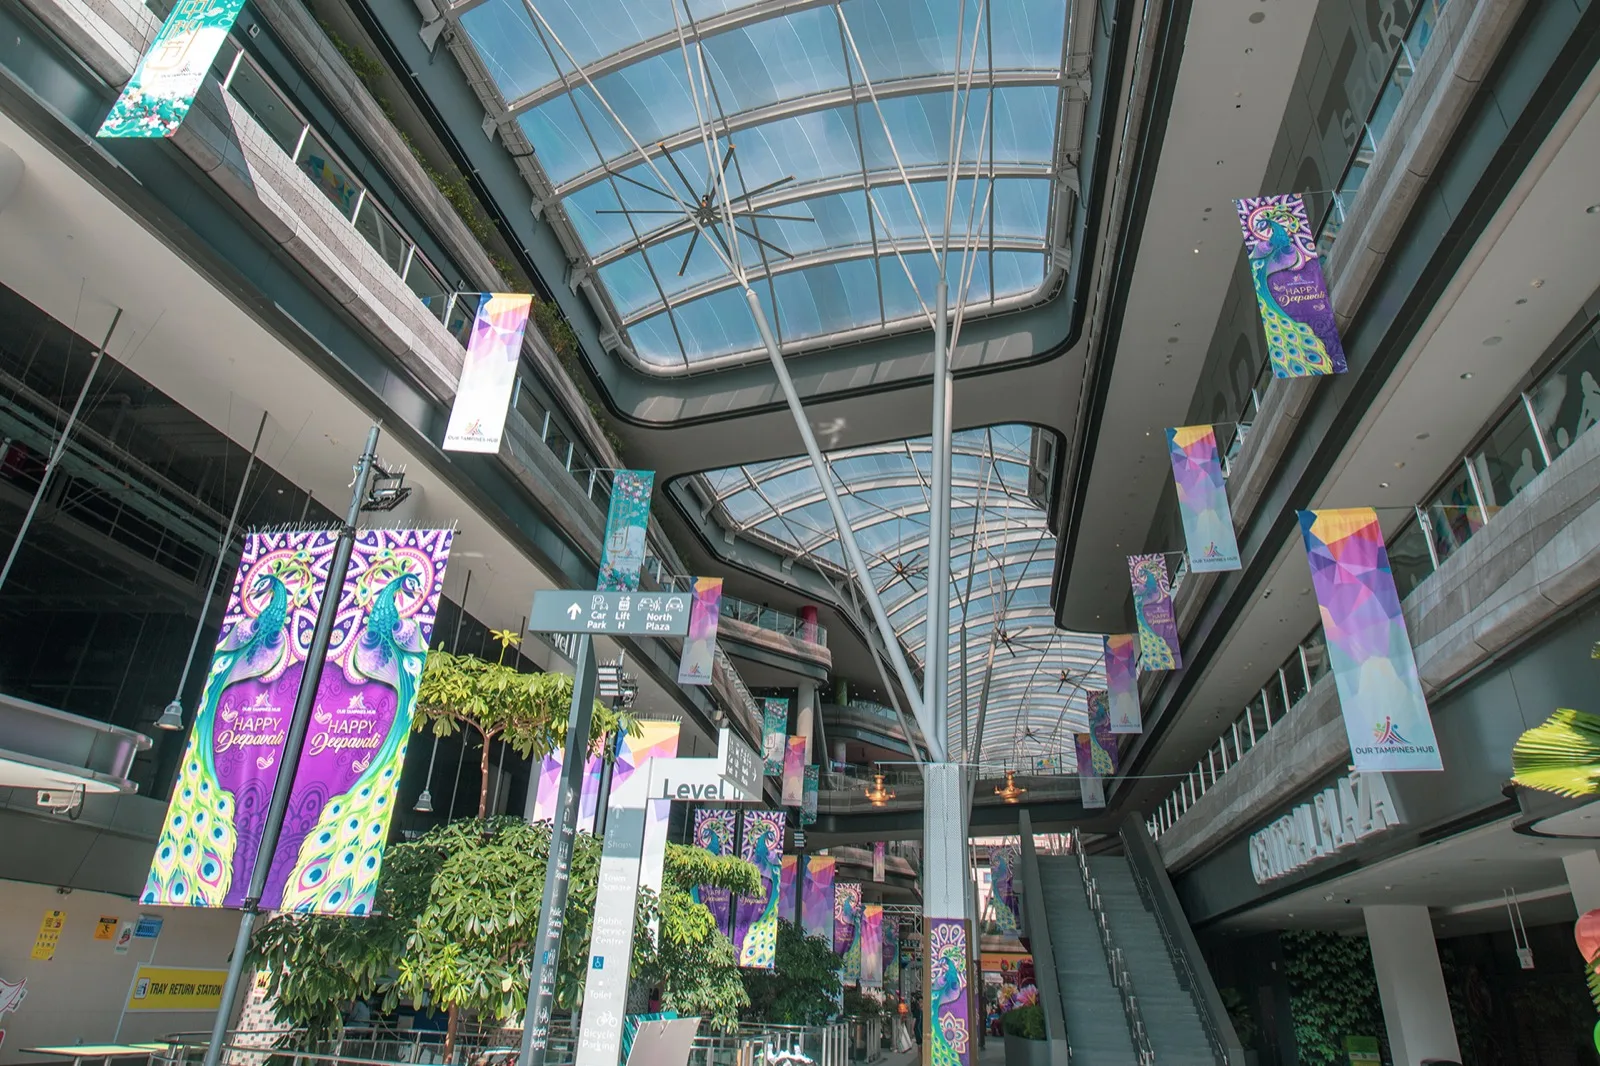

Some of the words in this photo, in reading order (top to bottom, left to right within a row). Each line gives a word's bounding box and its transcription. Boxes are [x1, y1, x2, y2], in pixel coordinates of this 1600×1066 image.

[1285, 285, 1318, 295] HAPPY
[1279, 291, 1325, 306] Deepavali
[591, 611, 607, 620] Car
[615, 611, 631, 620] Lift
[646, 613, 672, 622] North
[587, 620, 607, 629] Park
[618, 621, 625, 629] H
[646, 622, 670, 631] Plaza
[233, 717, 282, 731] HAPPY
[327, 720, 377, 734] HAPPY
[215, 729, 286, 753] Deepavali
[309, 732, 382, 756] Deepavali
[1374, 746, 1415, 754] TAMPINES
[1416, 745, 1435, 753] HUB
[663, 778, 725, 799] Level
[607, 841, 632, 849] Shops
[604, 873, 627, 881] Town
[602, 882, 632, 892] Square
[597, 916, 624, 925] Public
[596, 926, 627, 936] Service
[595, 936, 624, 945] Centre
[150, 983, 168, 995] TRAY
[169, 983, 195, 995] RETURN
[196, 984, 222, 996] STATION
[590, 989, 612, 999] Toilet
[583, 1028, 615, 1039] Bicycle
[582, 1039, 616, 1052] Parking
